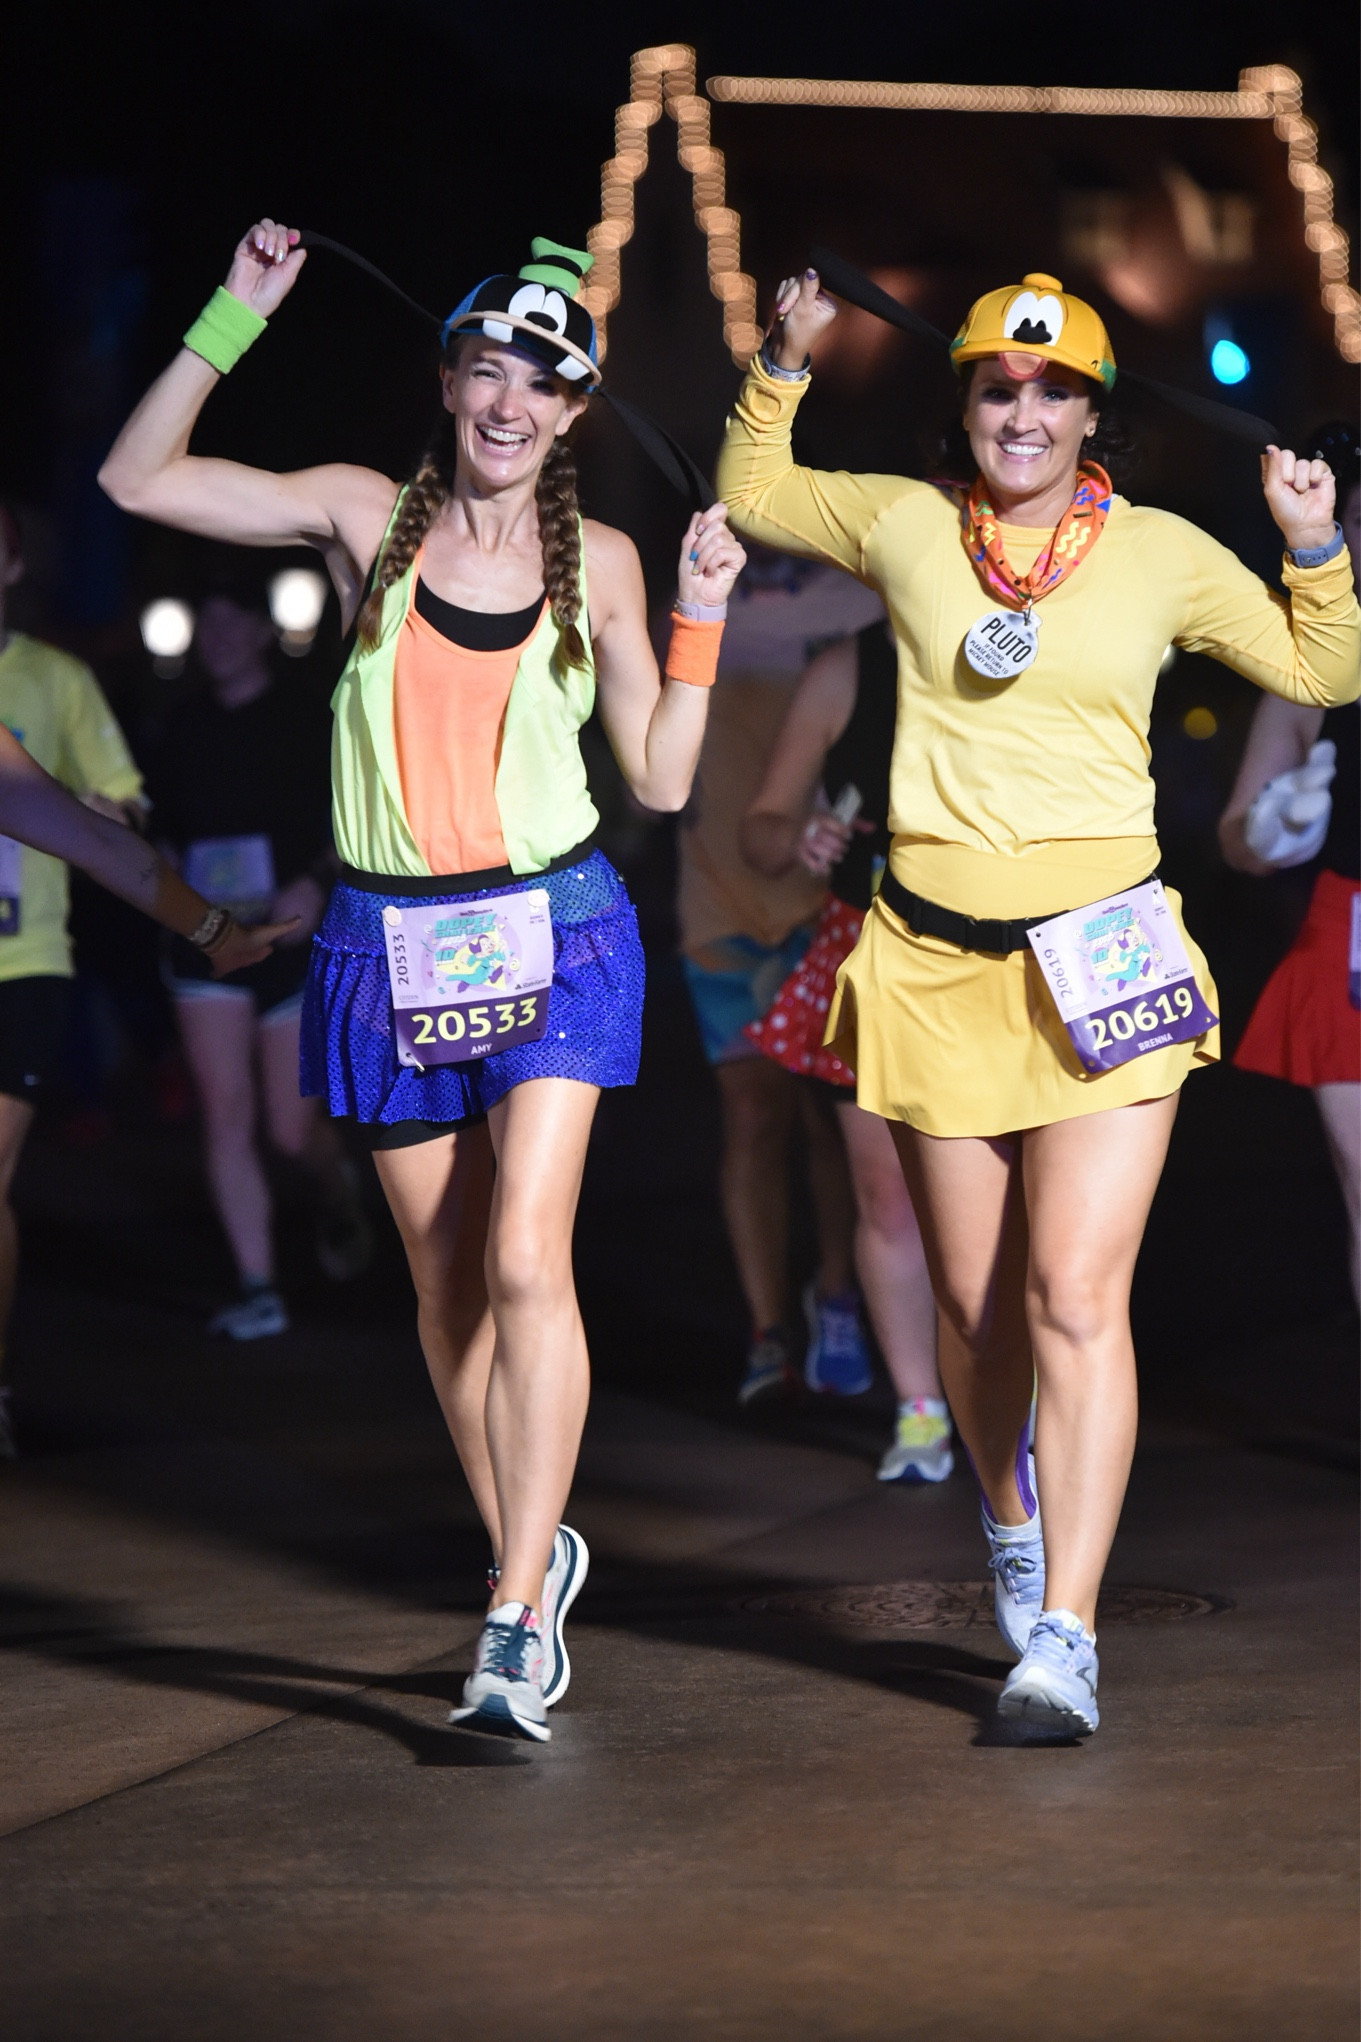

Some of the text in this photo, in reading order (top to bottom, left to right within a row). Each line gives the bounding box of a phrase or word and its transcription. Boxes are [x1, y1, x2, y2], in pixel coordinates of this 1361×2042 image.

[980, 616, 1032, 663] PLUTO
[989, 647, 1005, 662] FOUND
[968, 648, 1000, 676] MICKEY MOUSE
[970, 640, 1009, 675] PLEASE RETURN TO
[435, 913, 498, 931] DOPEY
[1083, 907, 1132, 935] DOPEY
[393, 934, 409, 985] 20533
[1043, 948, 1074, 998] 20619
[411, 996, 537, 1044] 20533
[1085, 987, 1193, 1051] 20619
[470, 1043, 492, 1055] AMY
[1137, 1033, 1173, 1052] BRENNA
